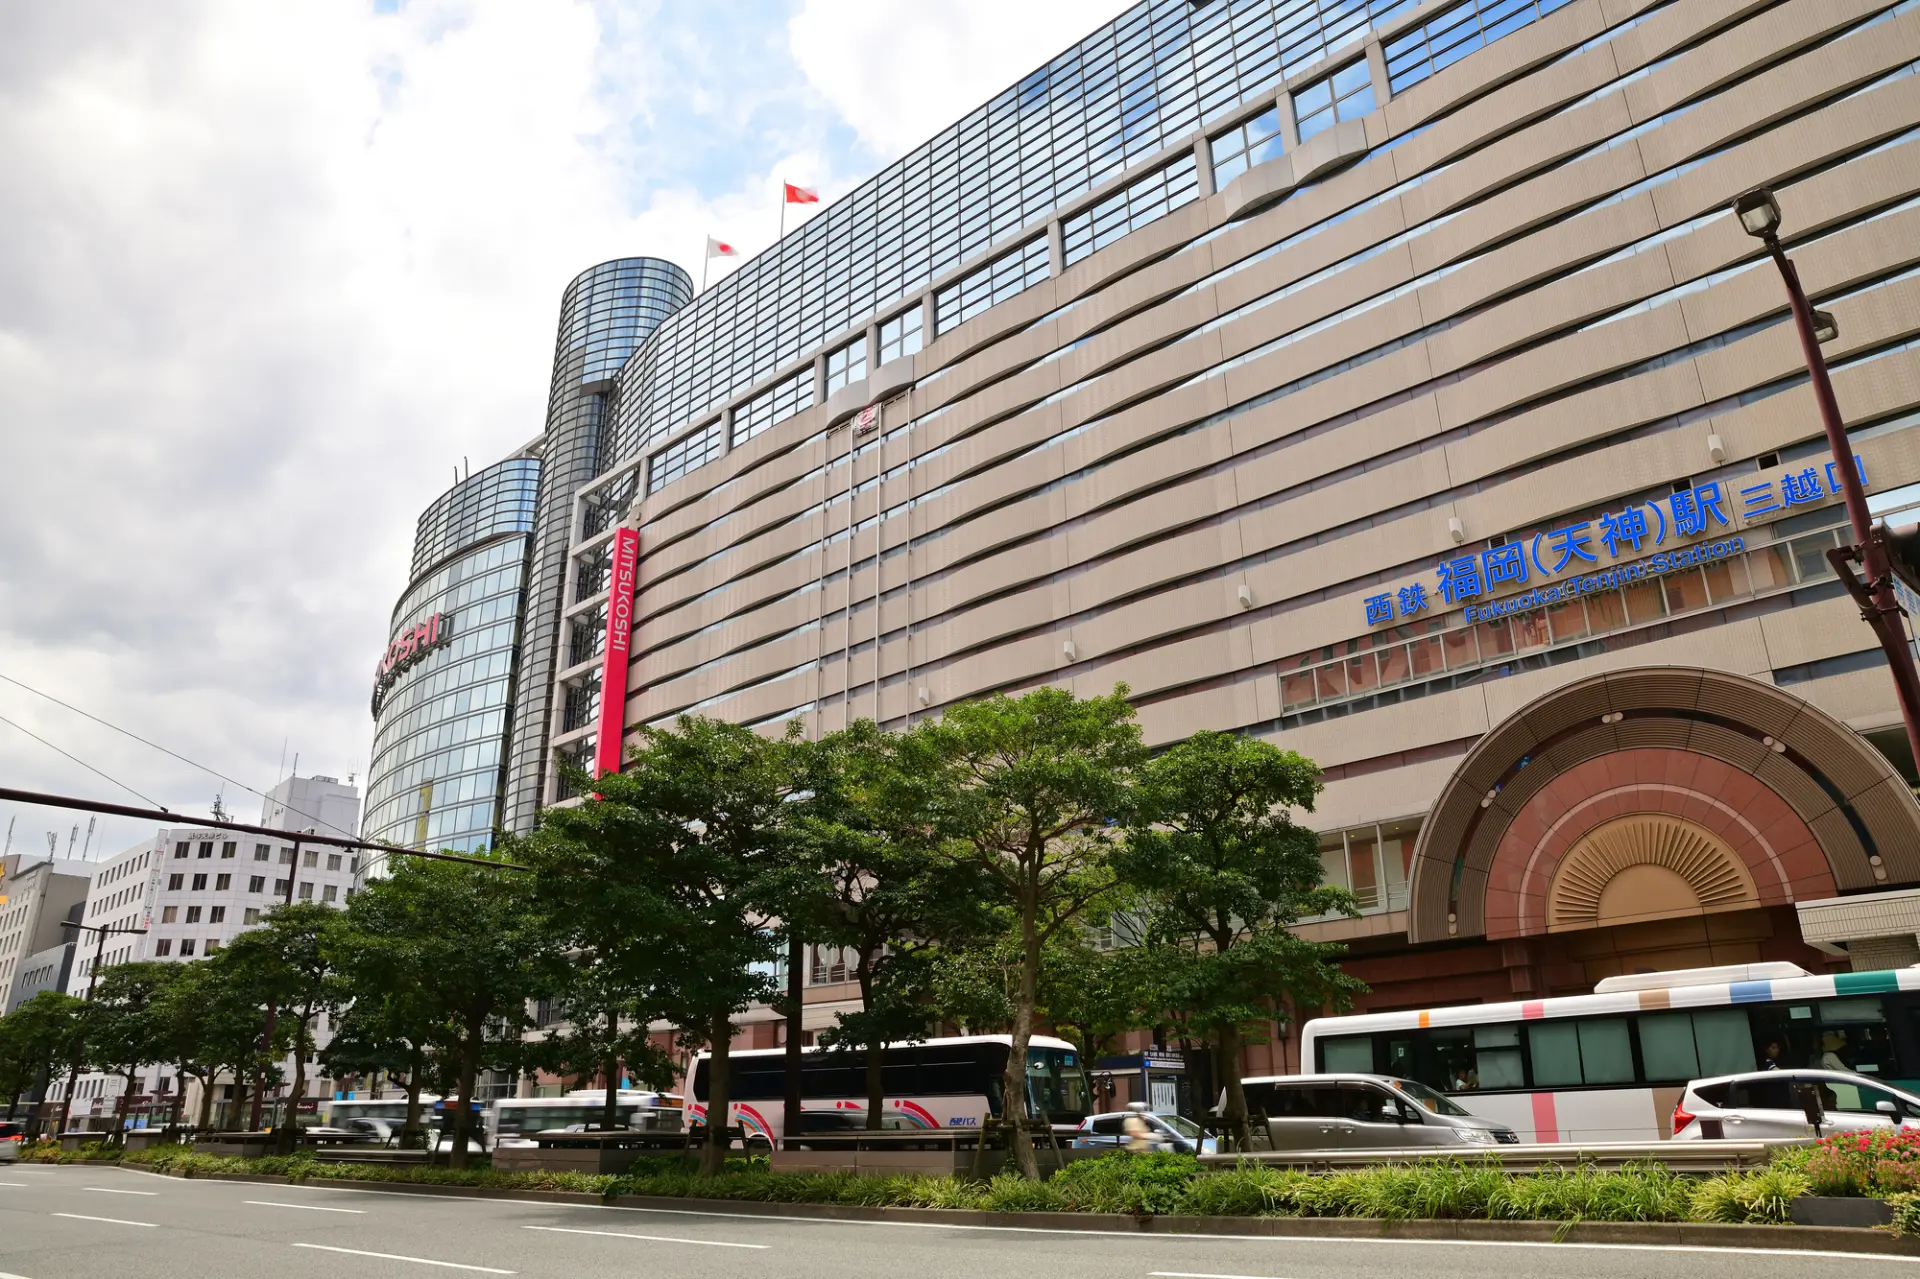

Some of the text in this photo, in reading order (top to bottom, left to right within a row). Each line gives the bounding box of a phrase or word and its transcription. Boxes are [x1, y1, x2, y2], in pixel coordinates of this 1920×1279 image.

[1652, 537, 1746, 574] Station
[613, 536, 636, 651] MITSUKOSHI
[1363, 582, 1428, 626] 西鉄
[377, 612, 441, 682] KOSHI
